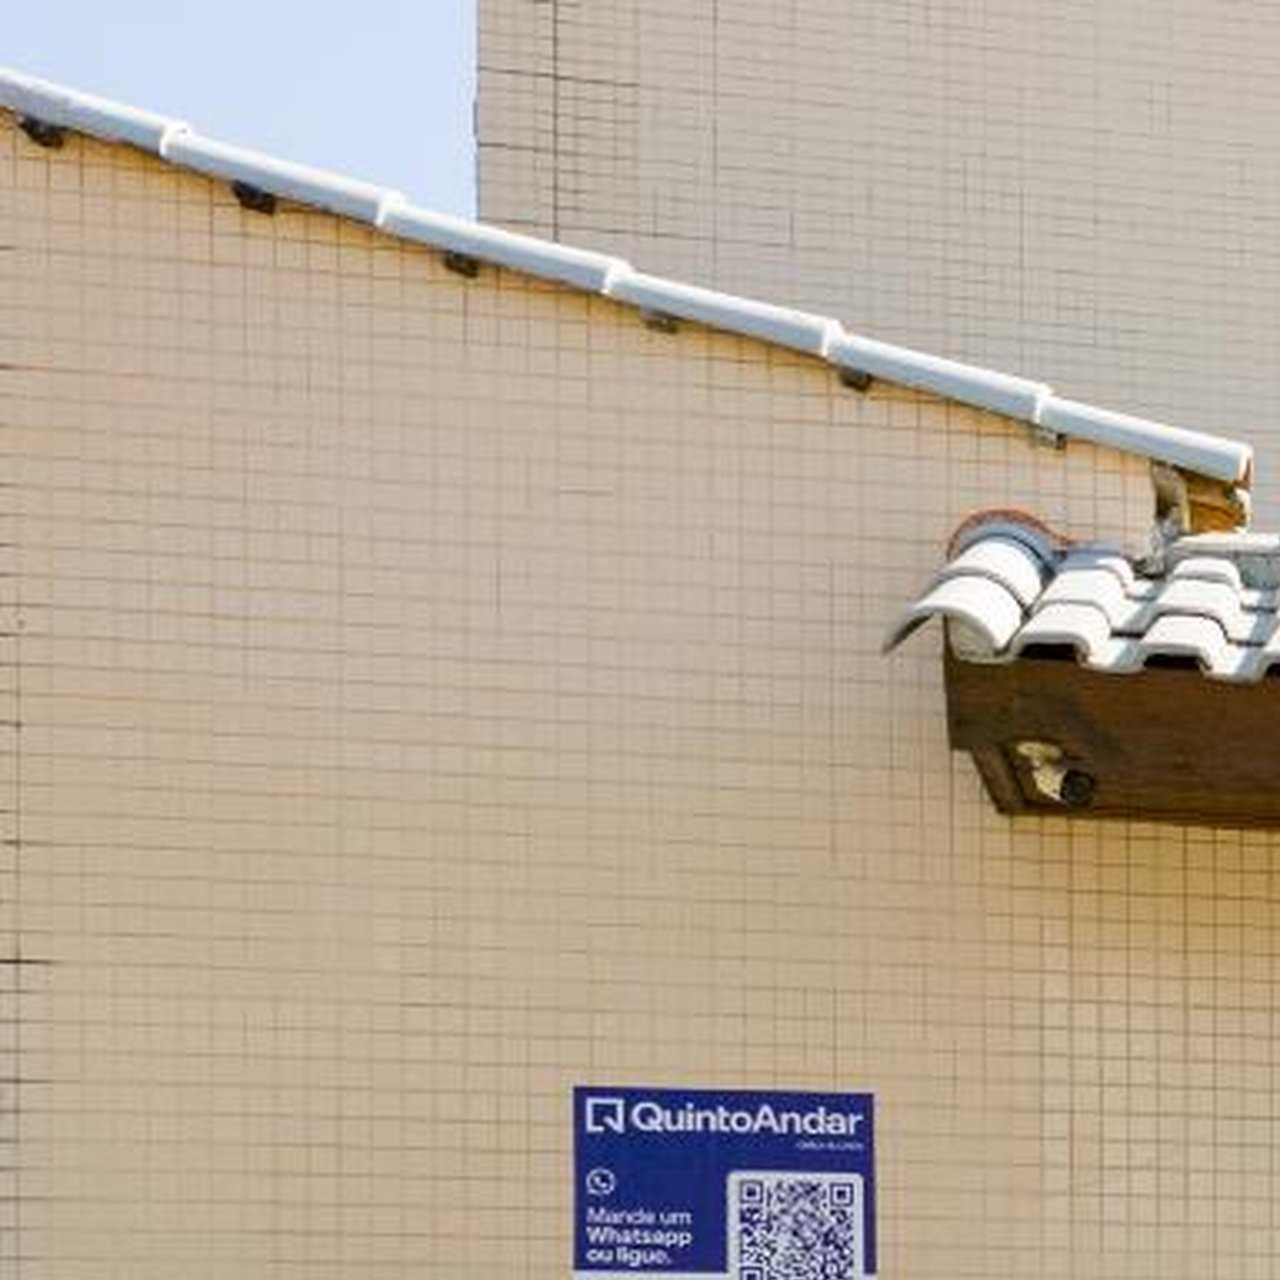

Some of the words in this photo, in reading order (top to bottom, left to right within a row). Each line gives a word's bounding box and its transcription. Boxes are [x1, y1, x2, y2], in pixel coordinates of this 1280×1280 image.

[631, 1101, 864, 1135] QuintoAndar
[659, 1211, 693, 1225] um
[585, 1248, 614, 1263] ou
